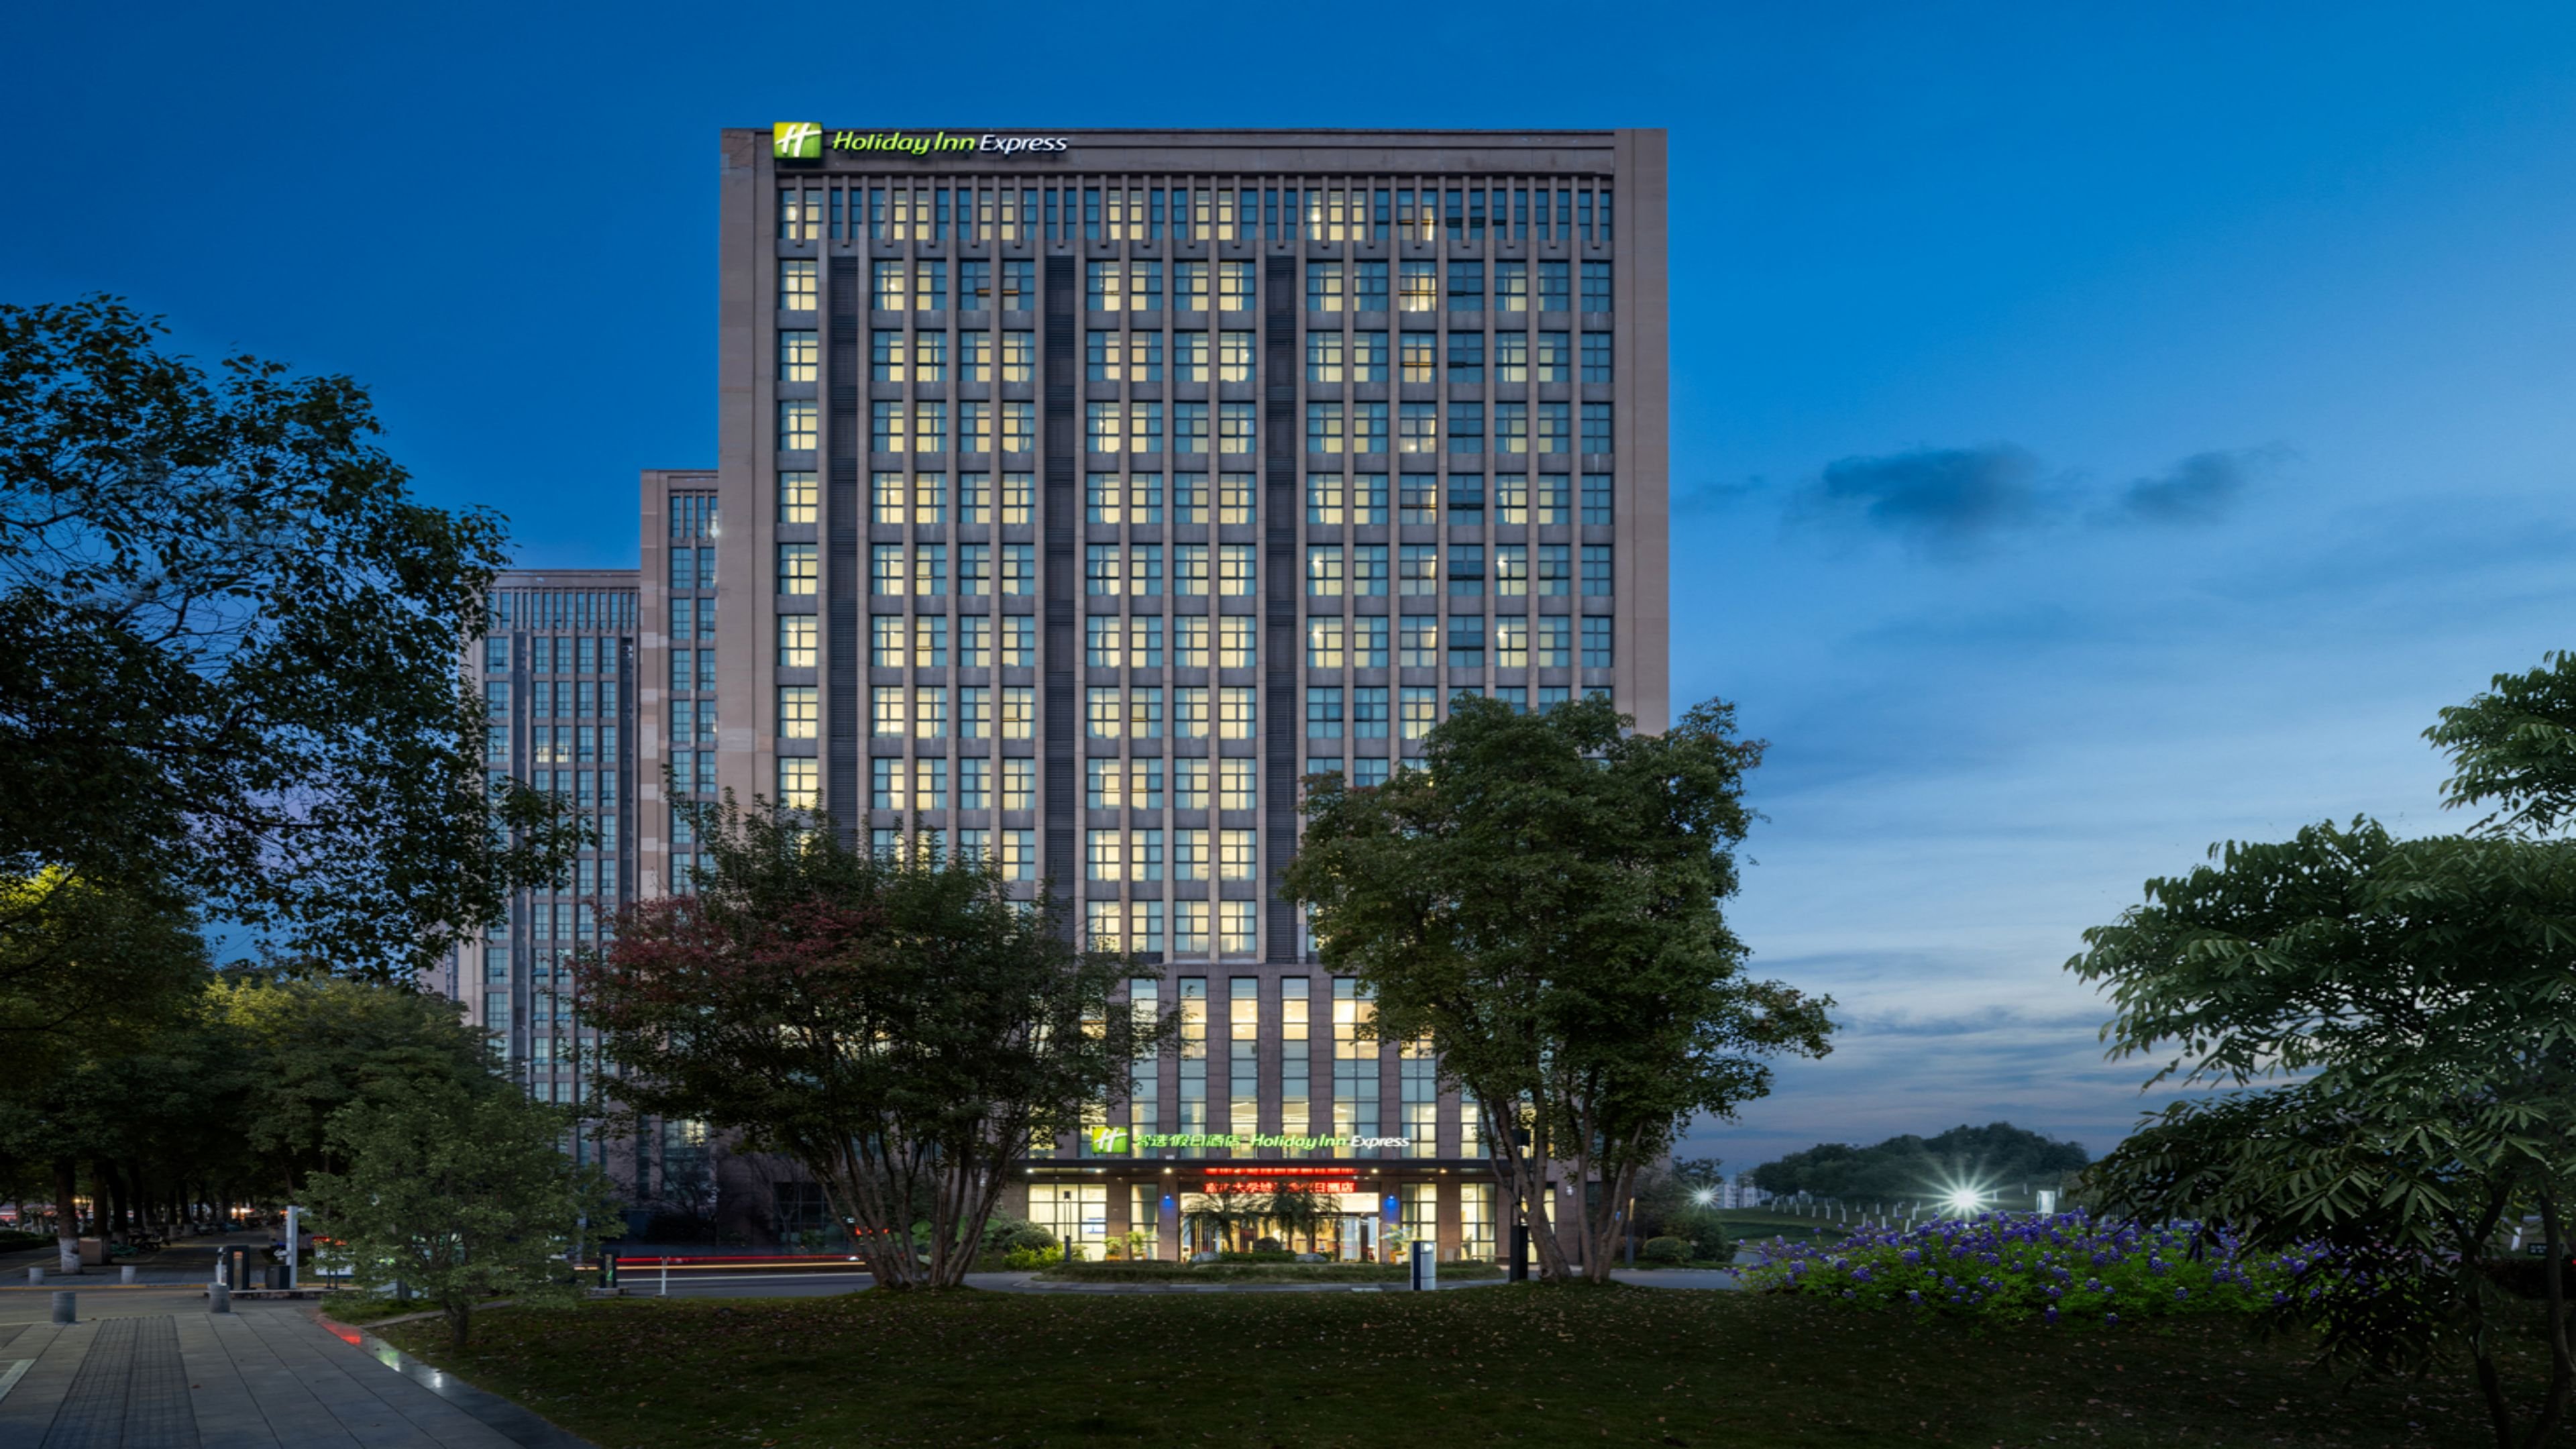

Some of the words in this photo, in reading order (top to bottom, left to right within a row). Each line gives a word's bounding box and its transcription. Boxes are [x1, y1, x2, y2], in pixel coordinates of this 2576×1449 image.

[833, 131, 930, 155] Holiday
[934, 131, 975, 151] Inn
[979, 135, 1068, 154] Express
[1250, 1133, 1316, 1150] Holiday
[1320, 1133, 1347, 1146] Inn
[1350, 1135, 1409, 1149] Express
